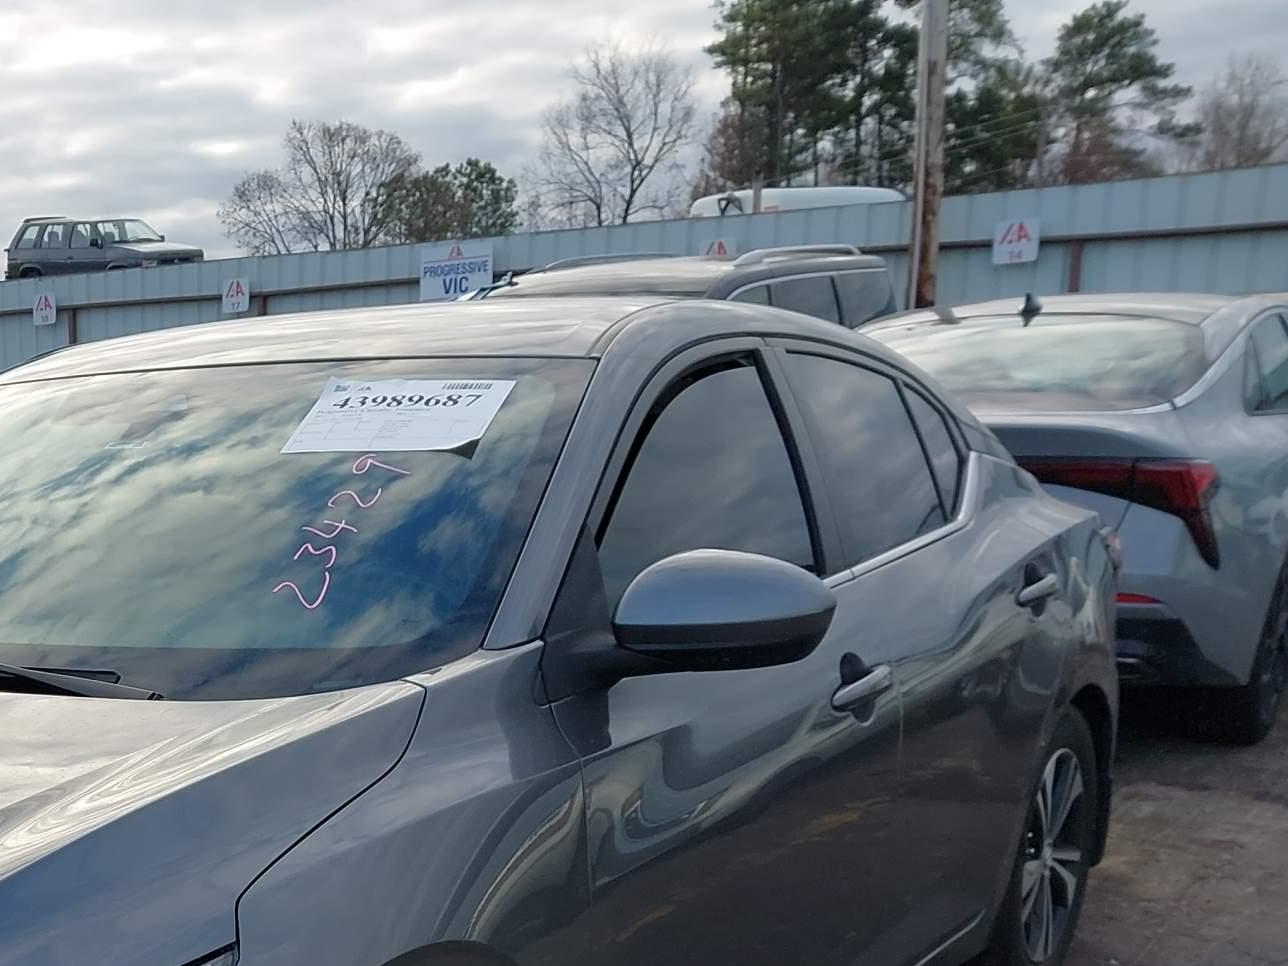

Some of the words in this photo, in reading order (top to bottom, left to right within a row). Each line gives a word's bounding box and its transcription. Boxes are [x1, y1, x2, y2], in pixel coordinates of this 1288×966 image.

[423, 260, 489, 278] PROGRESSIVE
[442, 276, 470, 295] VIC
[332, 393, 482, 409] 43989687
